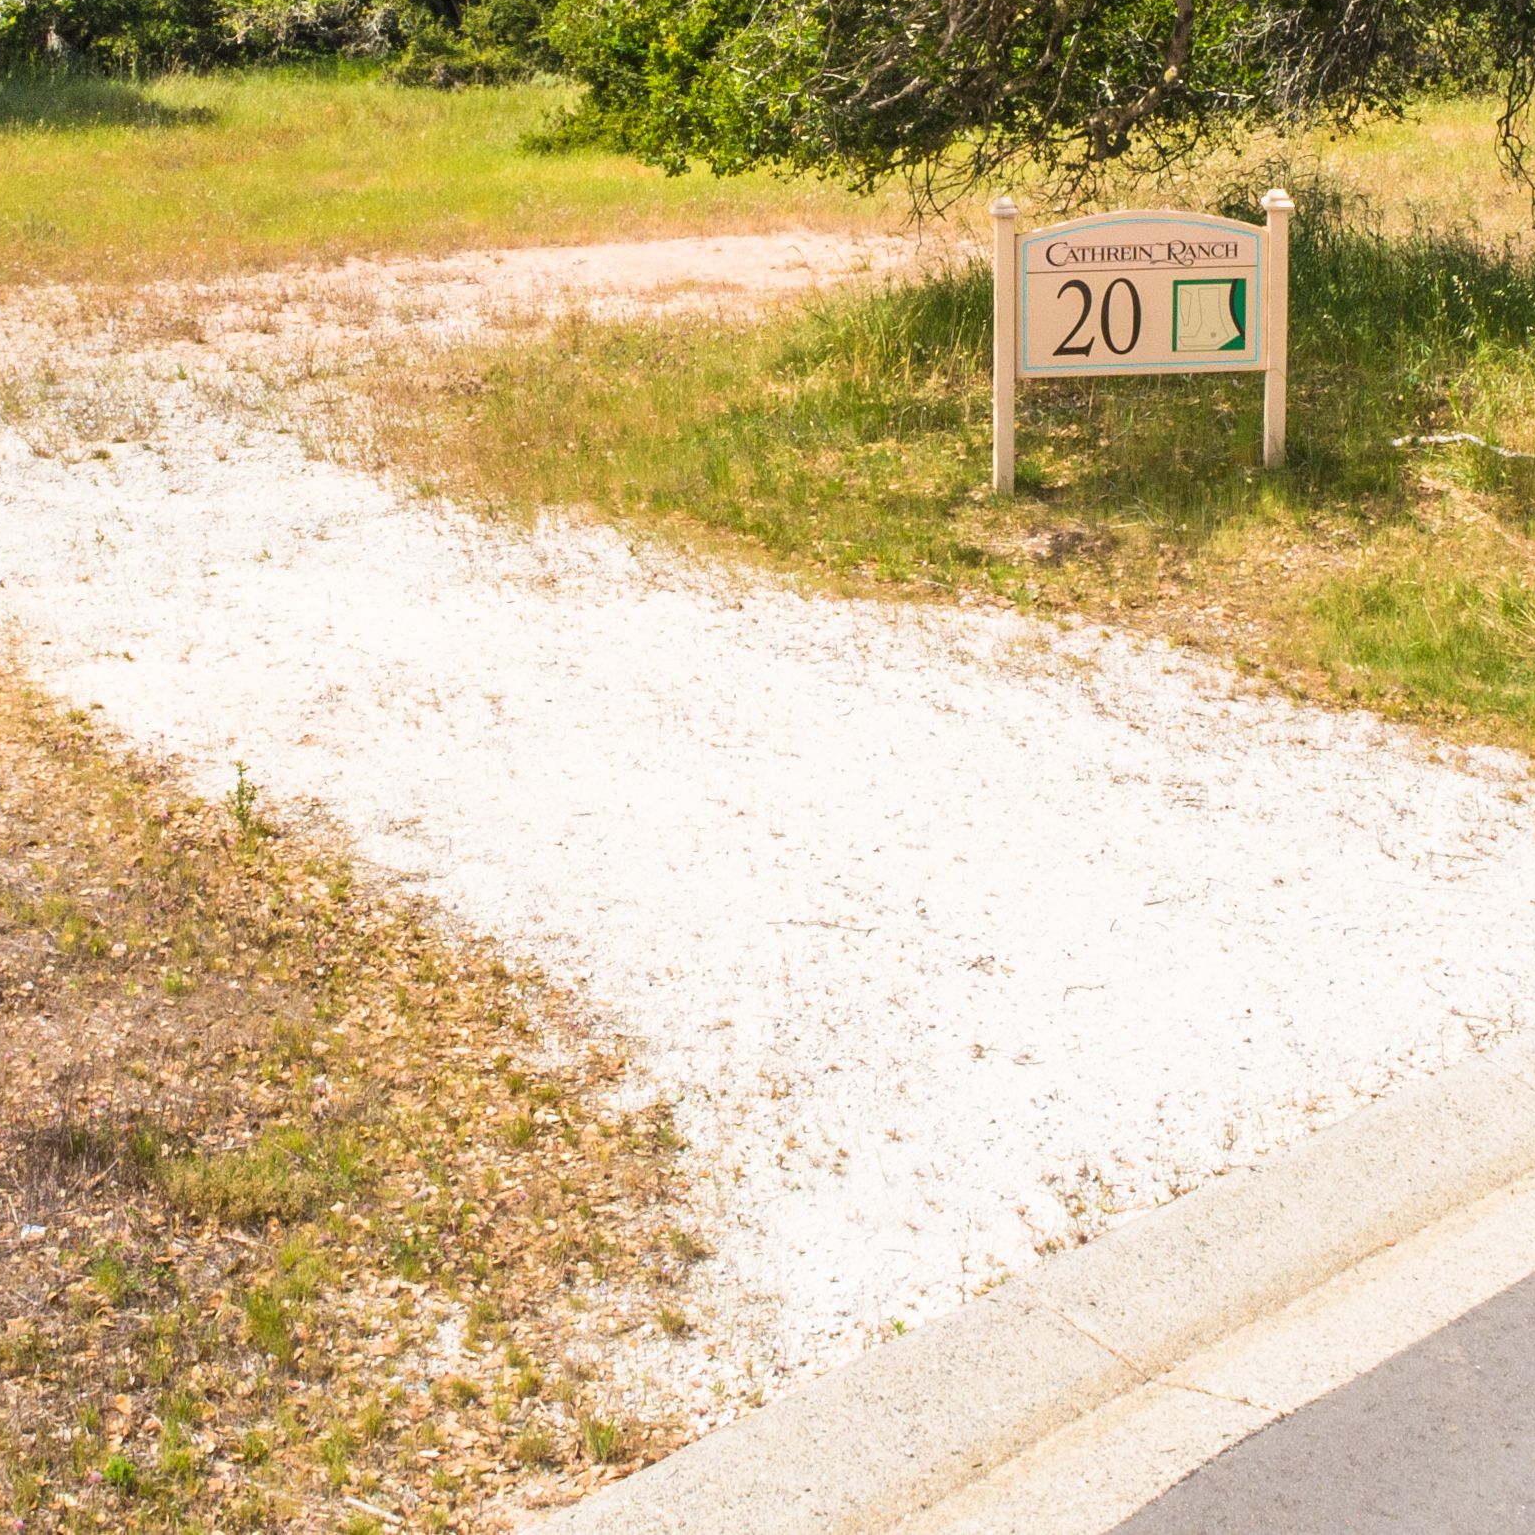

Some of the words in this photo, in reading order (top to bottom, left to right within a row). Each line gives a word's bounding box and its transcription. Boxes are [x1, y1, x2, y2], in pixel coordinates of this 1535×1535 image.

[1045, 241, 1153, 267] CATHREIN
[1152, 239, 1238, 266] RANCH
[1052, 277, 1142, 357] 20
